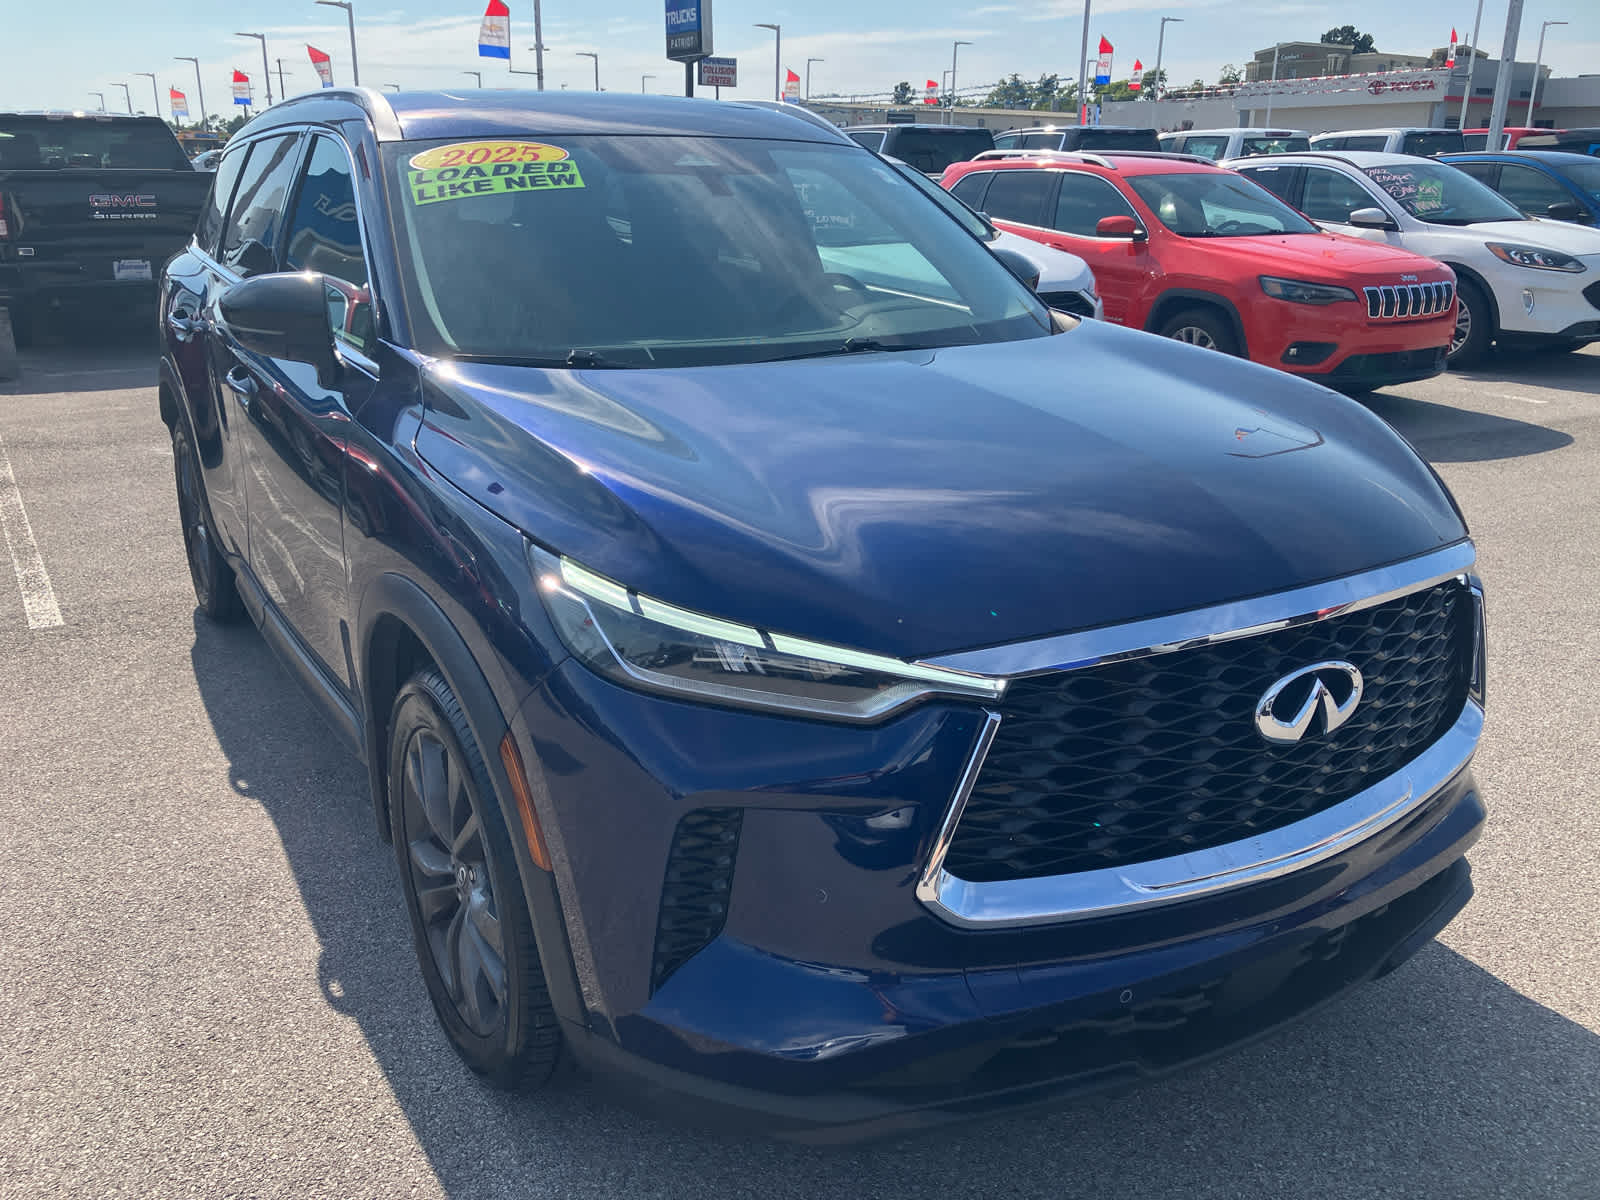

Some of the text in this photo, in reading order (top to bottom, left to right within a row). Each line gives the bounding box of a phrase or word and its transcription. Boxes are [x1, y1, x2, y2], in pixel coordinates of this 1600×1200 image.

[666, 8, 696, 24] TRUCKS
[703, 65, 736, 75] COLLISION
[707, 76, 731, 84] CENTER
[1390, 80, 1435, 92] TOYOTA
[439, 146, 542, 167] 2025
[414, 162, 571, 184] LOADED
[417, 173, 577, 201] LIKE NEW
[89, 195, 156, 207] GMC
